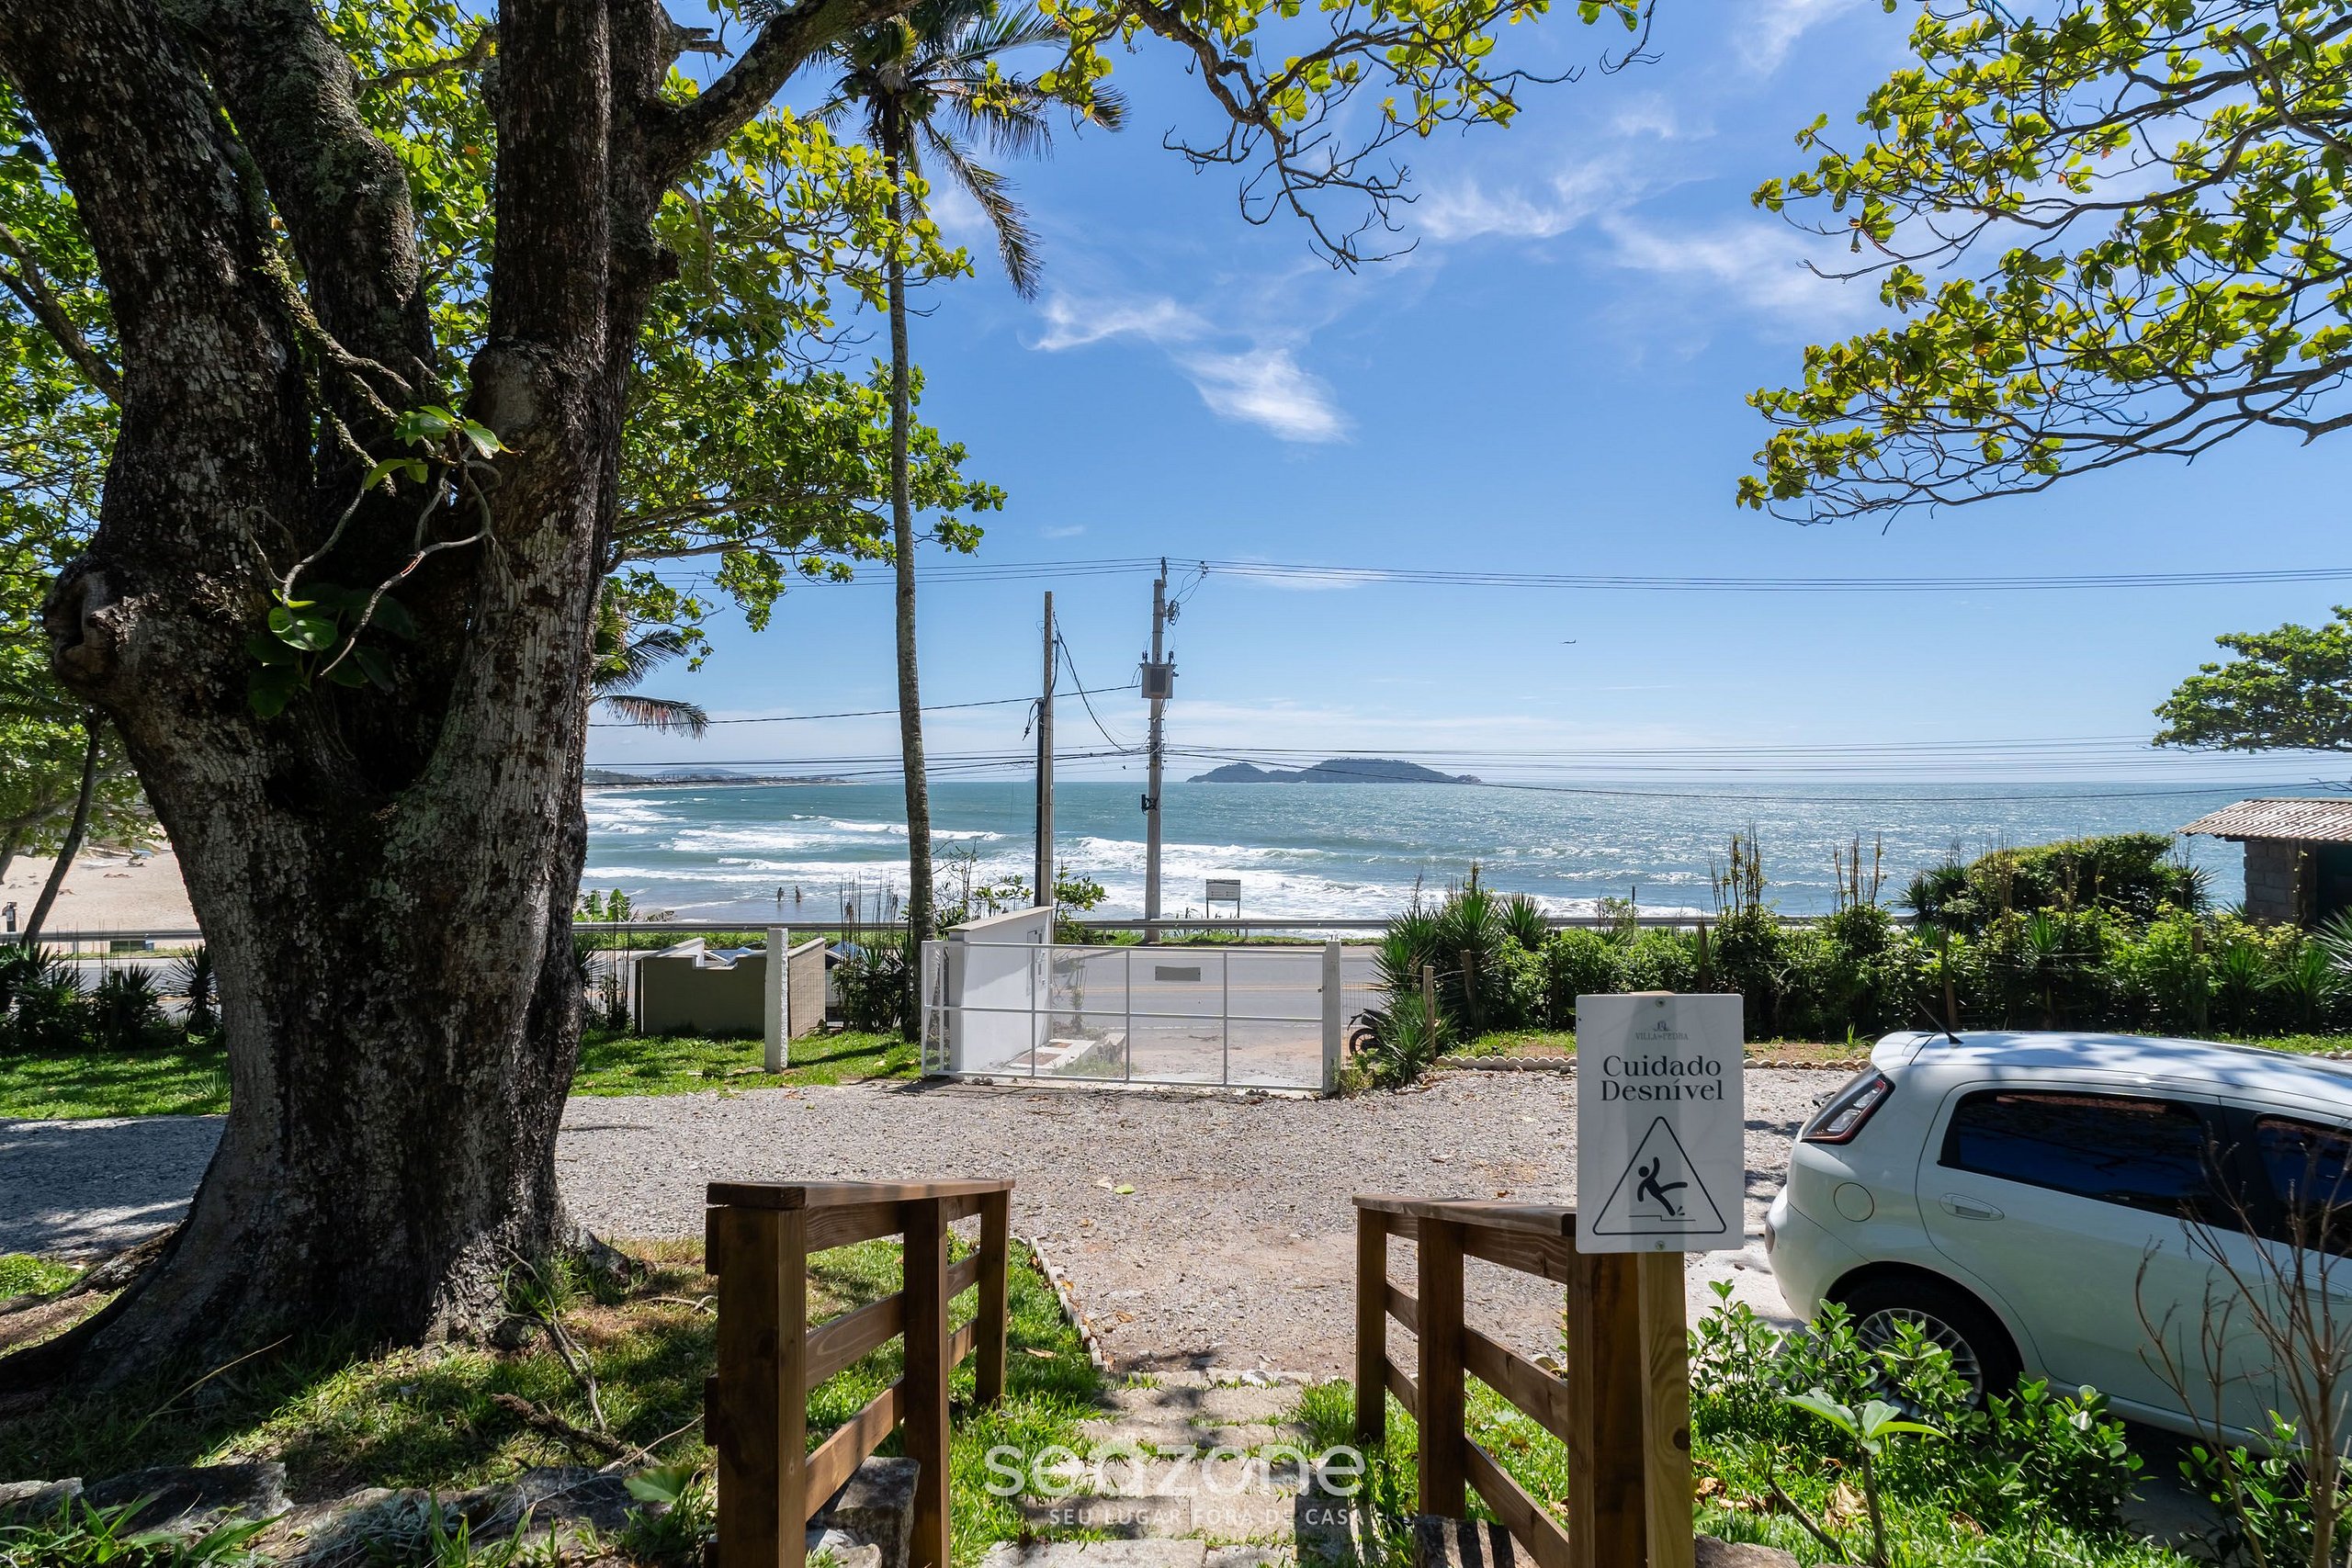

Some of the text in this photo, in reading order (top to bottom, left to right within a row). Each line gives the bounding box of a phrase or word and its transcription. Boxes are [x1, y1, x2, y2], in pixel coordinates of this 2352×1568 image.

[1635, 1032, 1657, 1040] VILLA
[1603, 1055, 1721, 1077] Cuidado
[1600, 1078, 1724, 1101] Desnível
